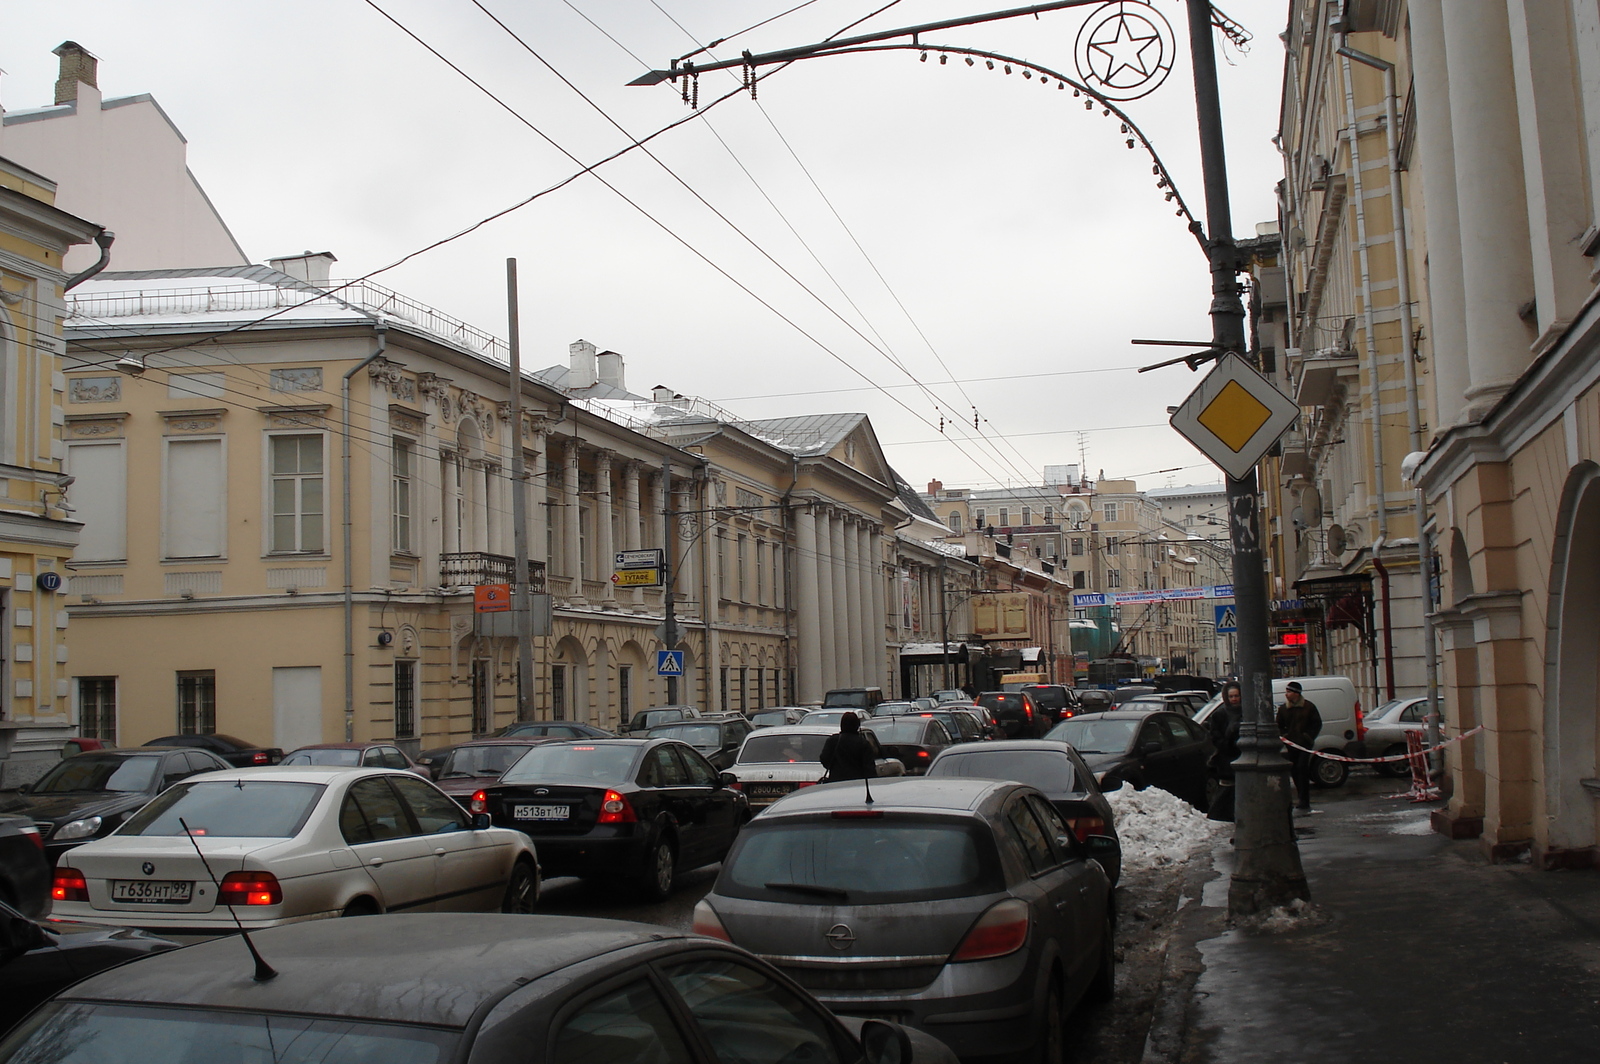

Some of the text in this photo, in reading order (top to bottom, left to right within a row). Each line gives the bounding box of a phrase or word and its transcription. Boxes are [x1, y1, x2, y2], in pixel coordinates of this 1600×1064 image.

[47, 575, 57, 587] 17
[516, 806, 567, 817] М513ВТ 177
[120, 882, 187, 897] Т636НТ 99
